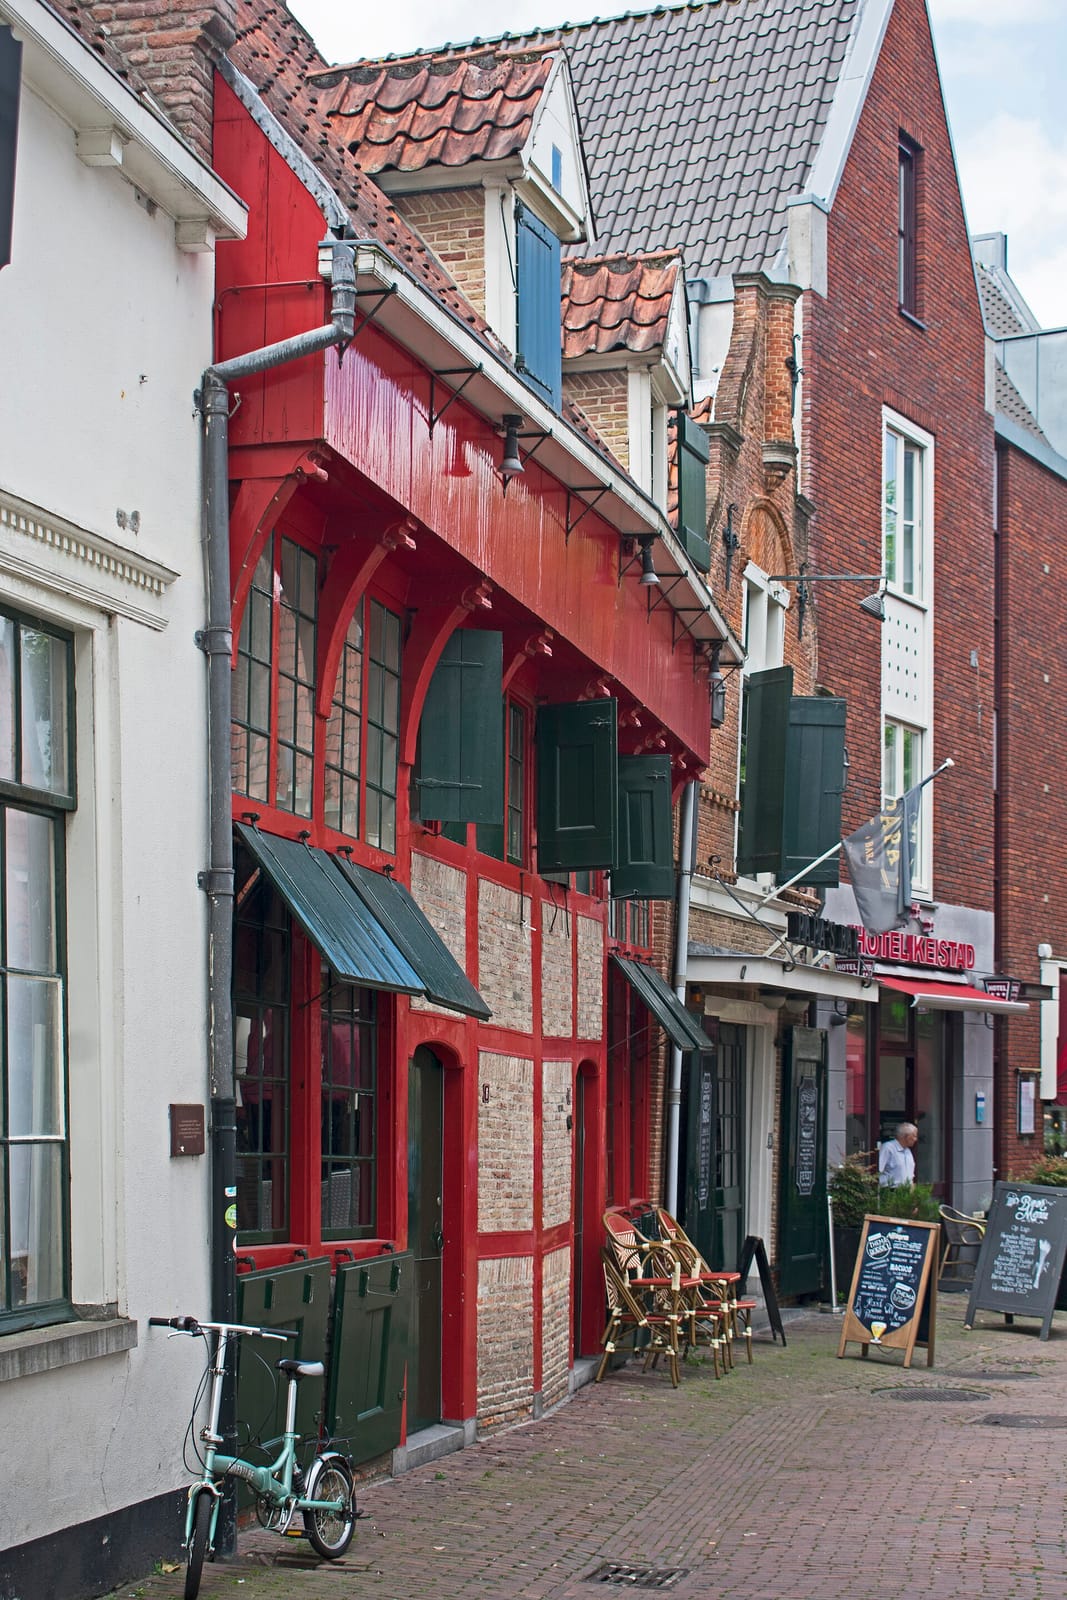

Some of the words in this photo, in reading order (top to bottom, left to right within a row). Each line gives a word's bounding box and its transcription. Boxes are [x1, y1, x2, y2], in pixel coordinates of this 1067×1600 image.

[857, 925, 910, 961] HOTEL
[912, 935, 975, 970] KEISTAD
[836, 963, 857, 971] HOTEL
[988, 984, 1007, 992] HOTEL
